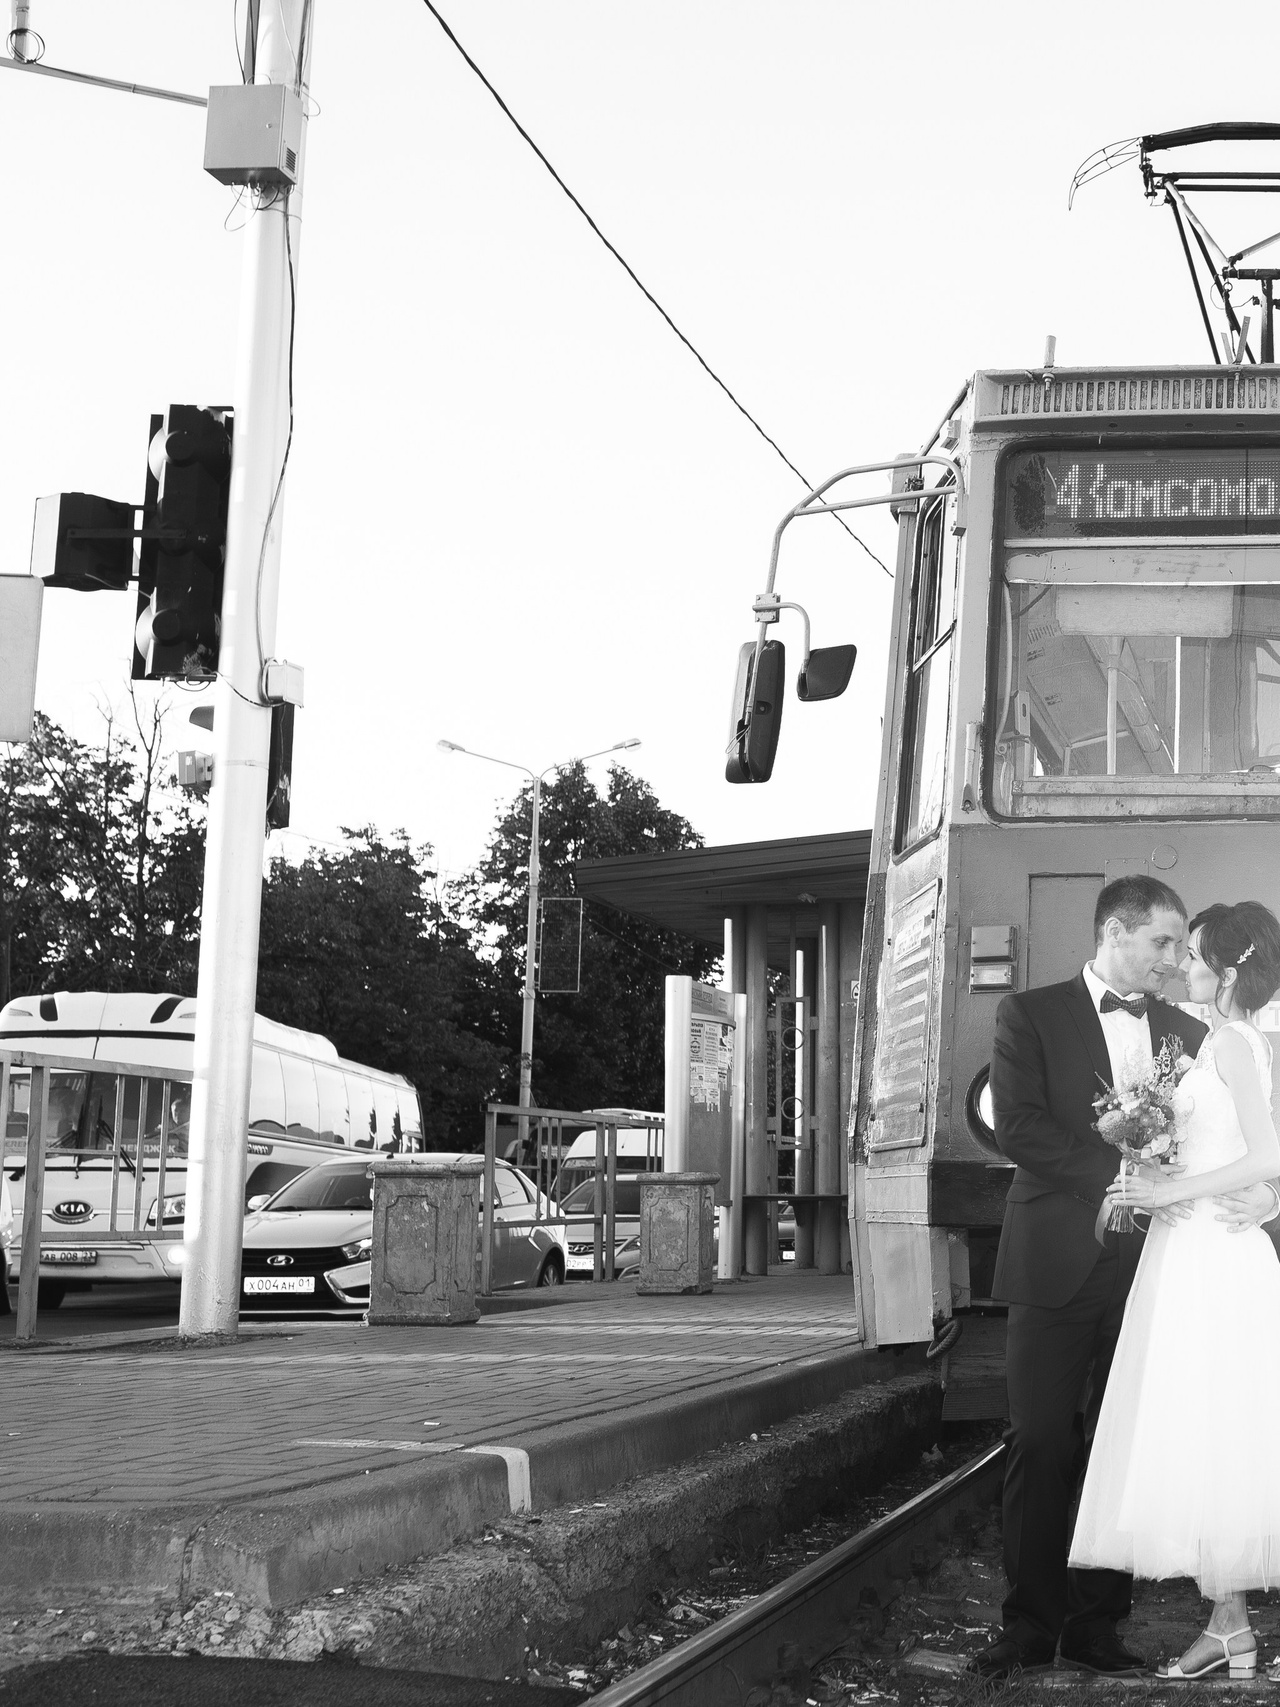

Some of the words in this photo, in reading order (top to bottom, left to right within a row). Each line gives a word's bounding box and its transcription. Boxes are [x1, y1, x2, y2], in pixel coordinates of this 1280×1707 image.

[1056, 463, 1082, 519] 4
[59, 1204, 85, 1214] KIA
[298, 1278, 310, 1287] 01
